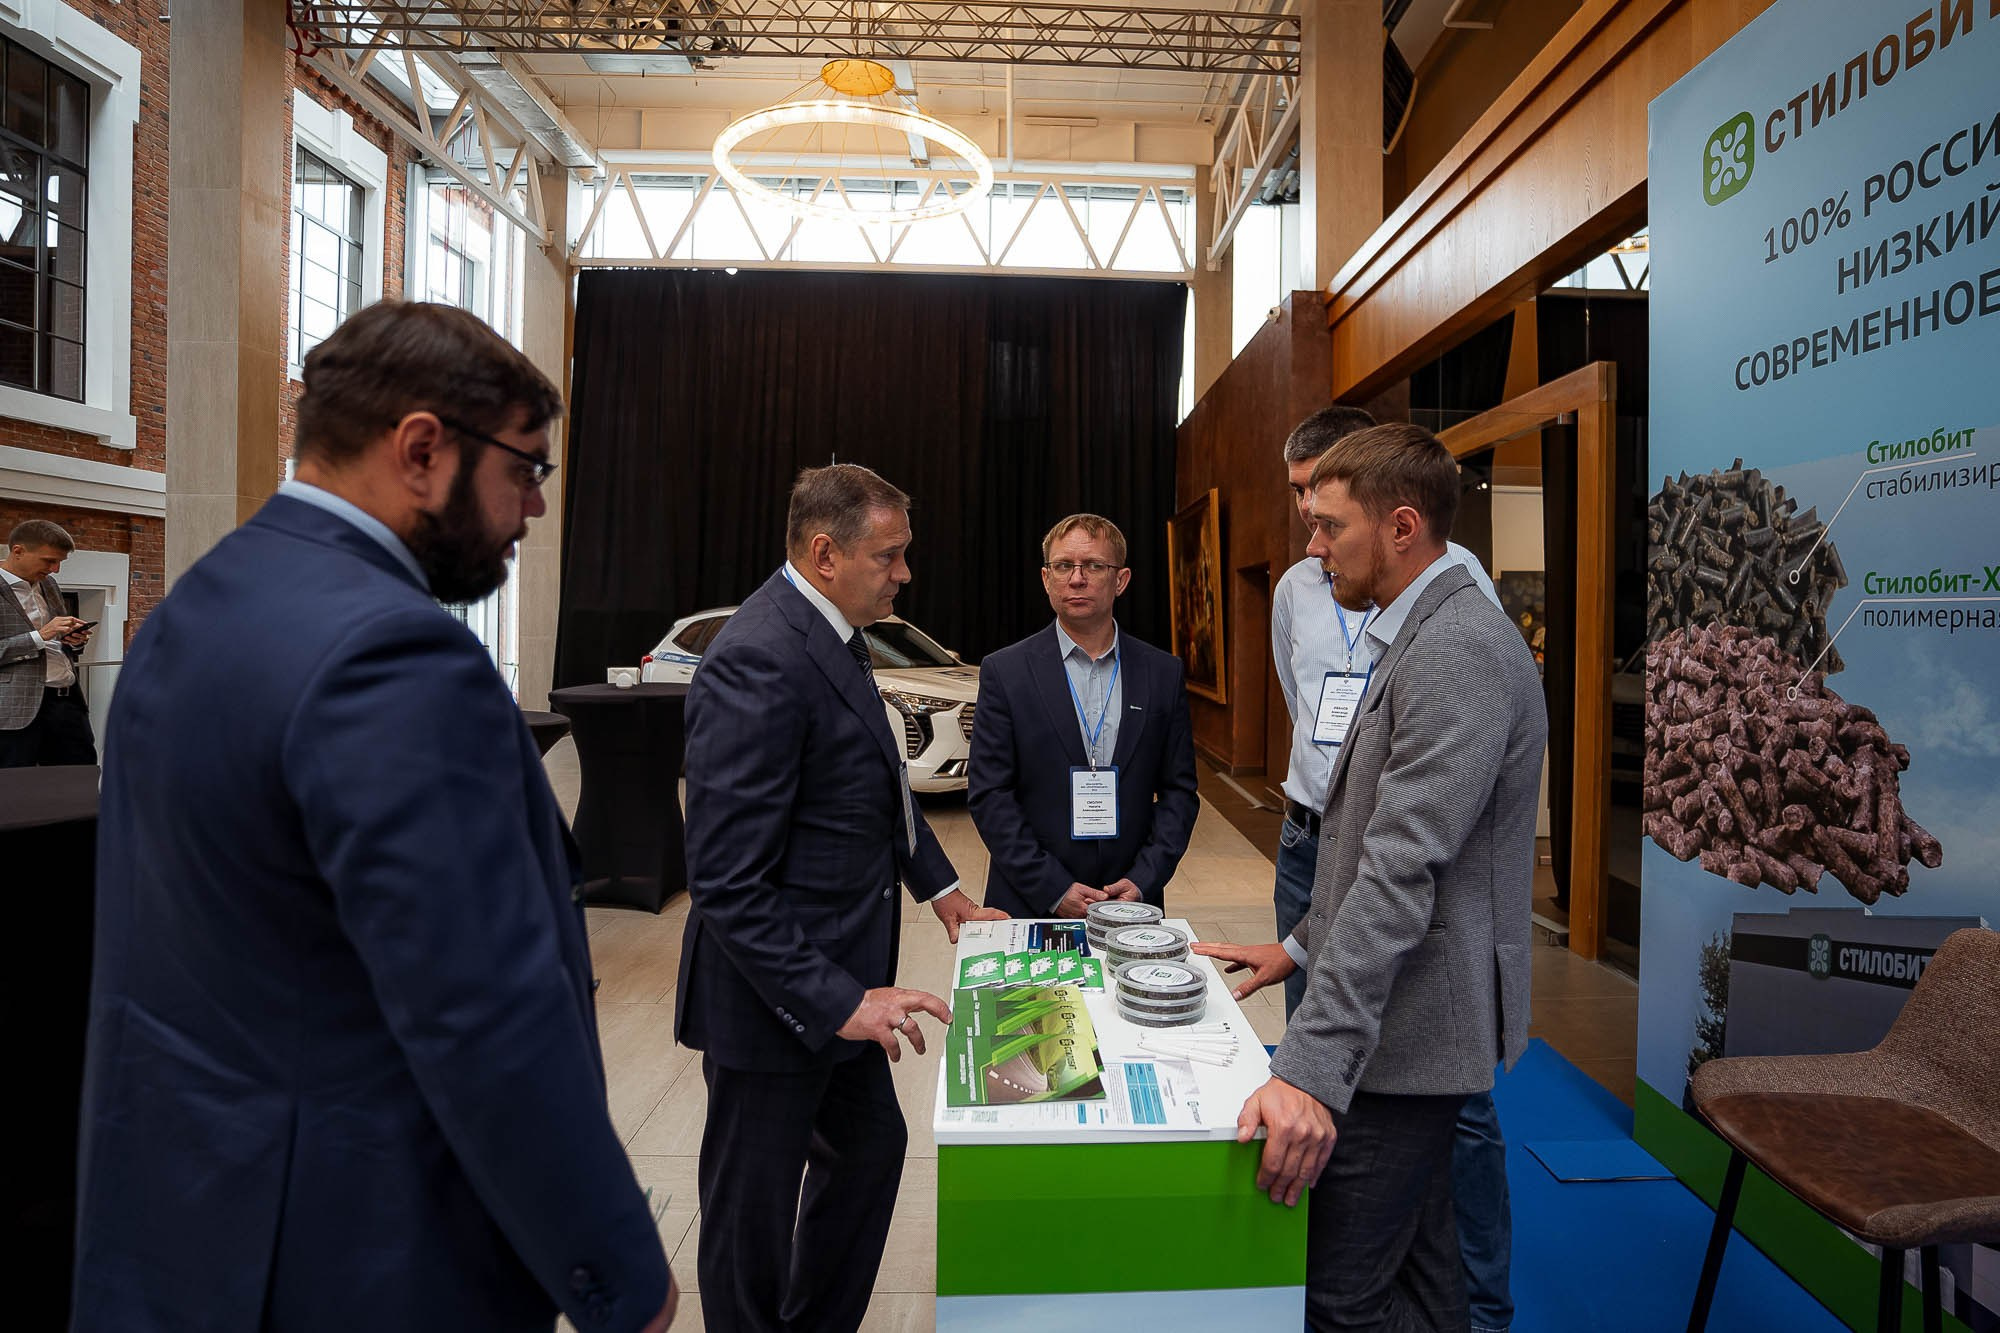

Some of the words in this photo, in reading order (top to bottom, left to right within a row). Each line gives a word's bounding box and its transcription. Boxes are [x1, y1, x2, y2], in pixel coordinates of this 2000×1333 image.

[1763, 190, 1851, 264] 100%
[1863, 111, 2000, 217] РОССИ
[1735, 269, 2000, 391] СОВРЕМЕННОЕ
[1866, 427, 1976, 464] Стилобит
[1866, 461, 2000, 500] стабилизир
[1863, 566, 2000, 595] Стилобит-Х
[1863, 606, 2000, 634] полимерна
